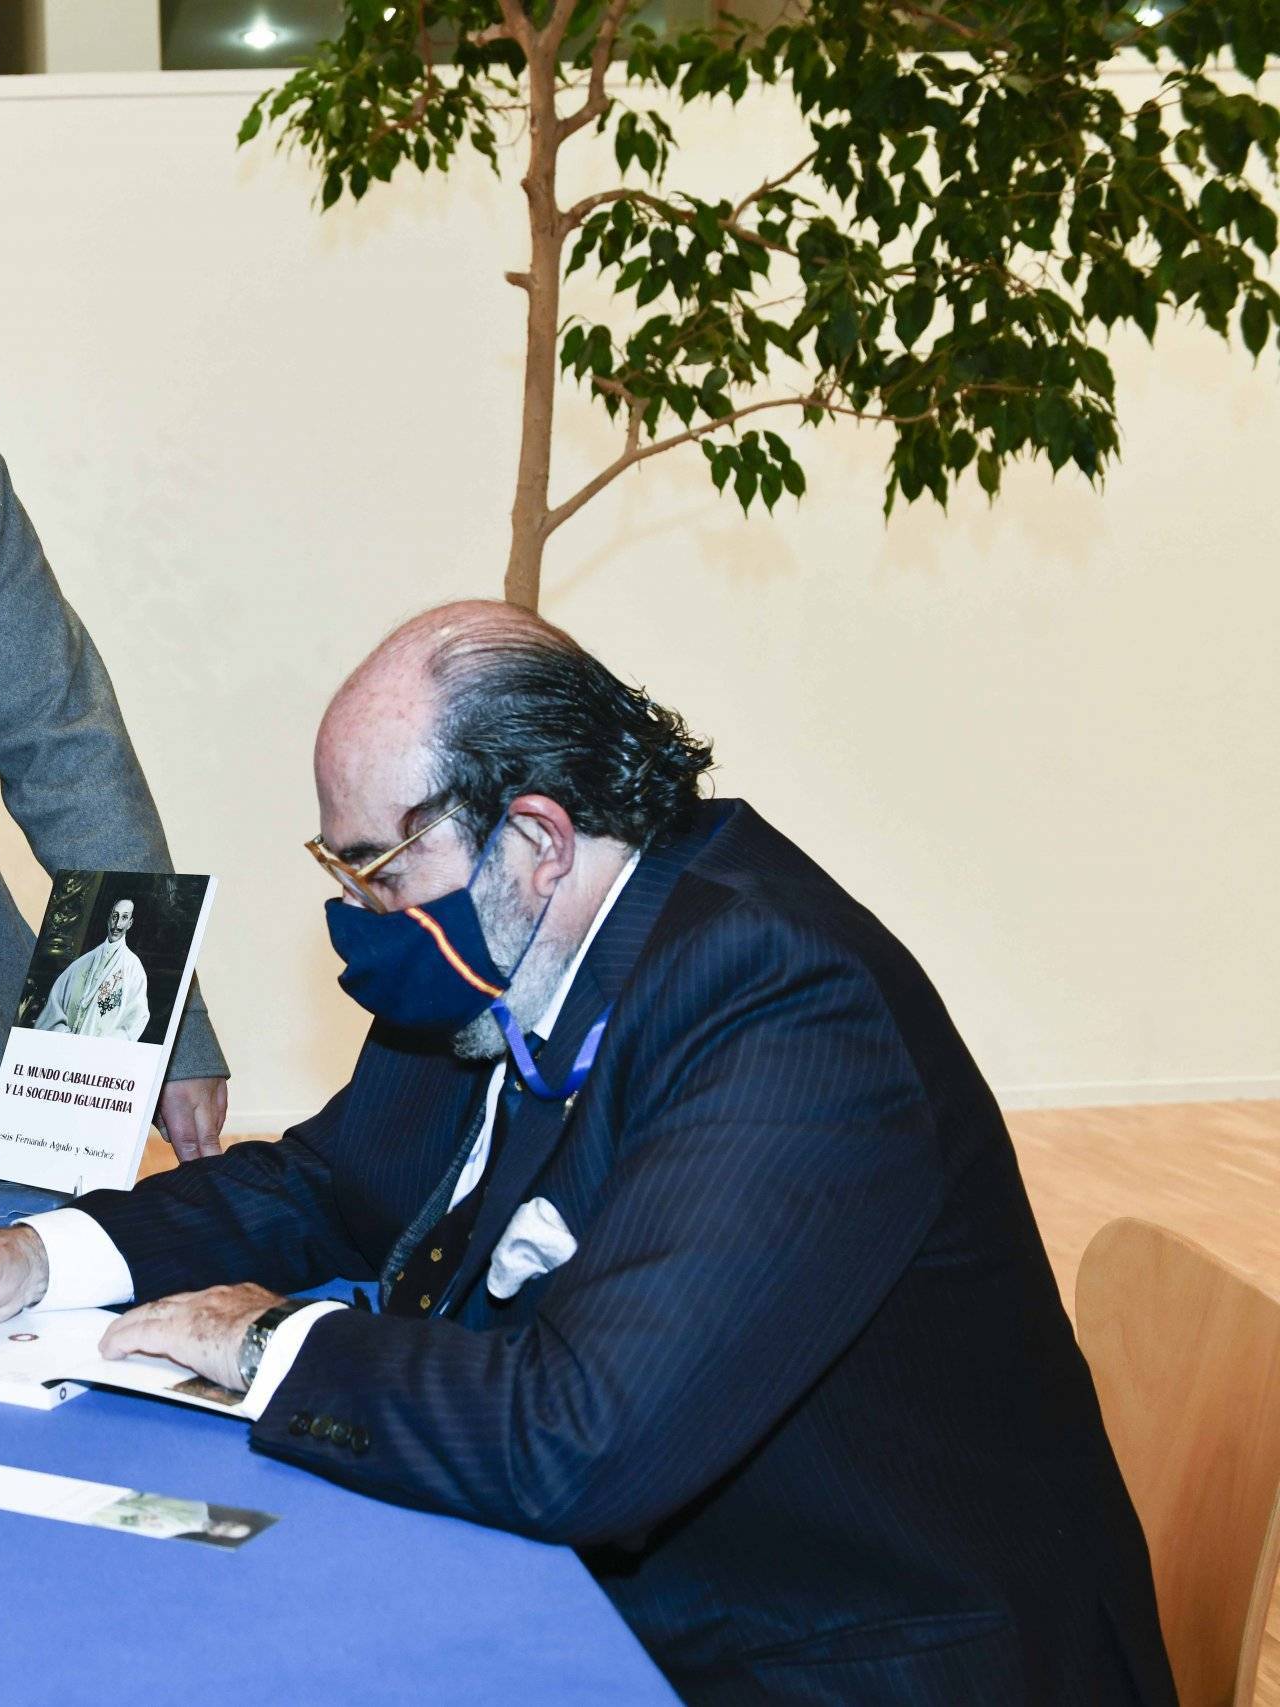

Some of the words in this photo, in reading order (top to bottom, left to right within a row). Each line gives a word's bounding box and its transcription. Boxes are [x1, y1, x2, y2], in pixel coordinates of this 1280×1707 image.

[14, 1064, 25, 1075] EL
[27, 1065, 60, 1081] MUNDO
[62, 1071, 135, 1092] CABALLERESCO
[5, 1083, 12, 1094] Y
[12, 1085, 24, 1096] LA
[25, 1087, 72, 1104] SOCIEDAD
[74, 1094, 133, 1114] IGUALITARIA
[16, 1133, 48, 1148] Fernando
[74, 1147, 80, 1156] y
